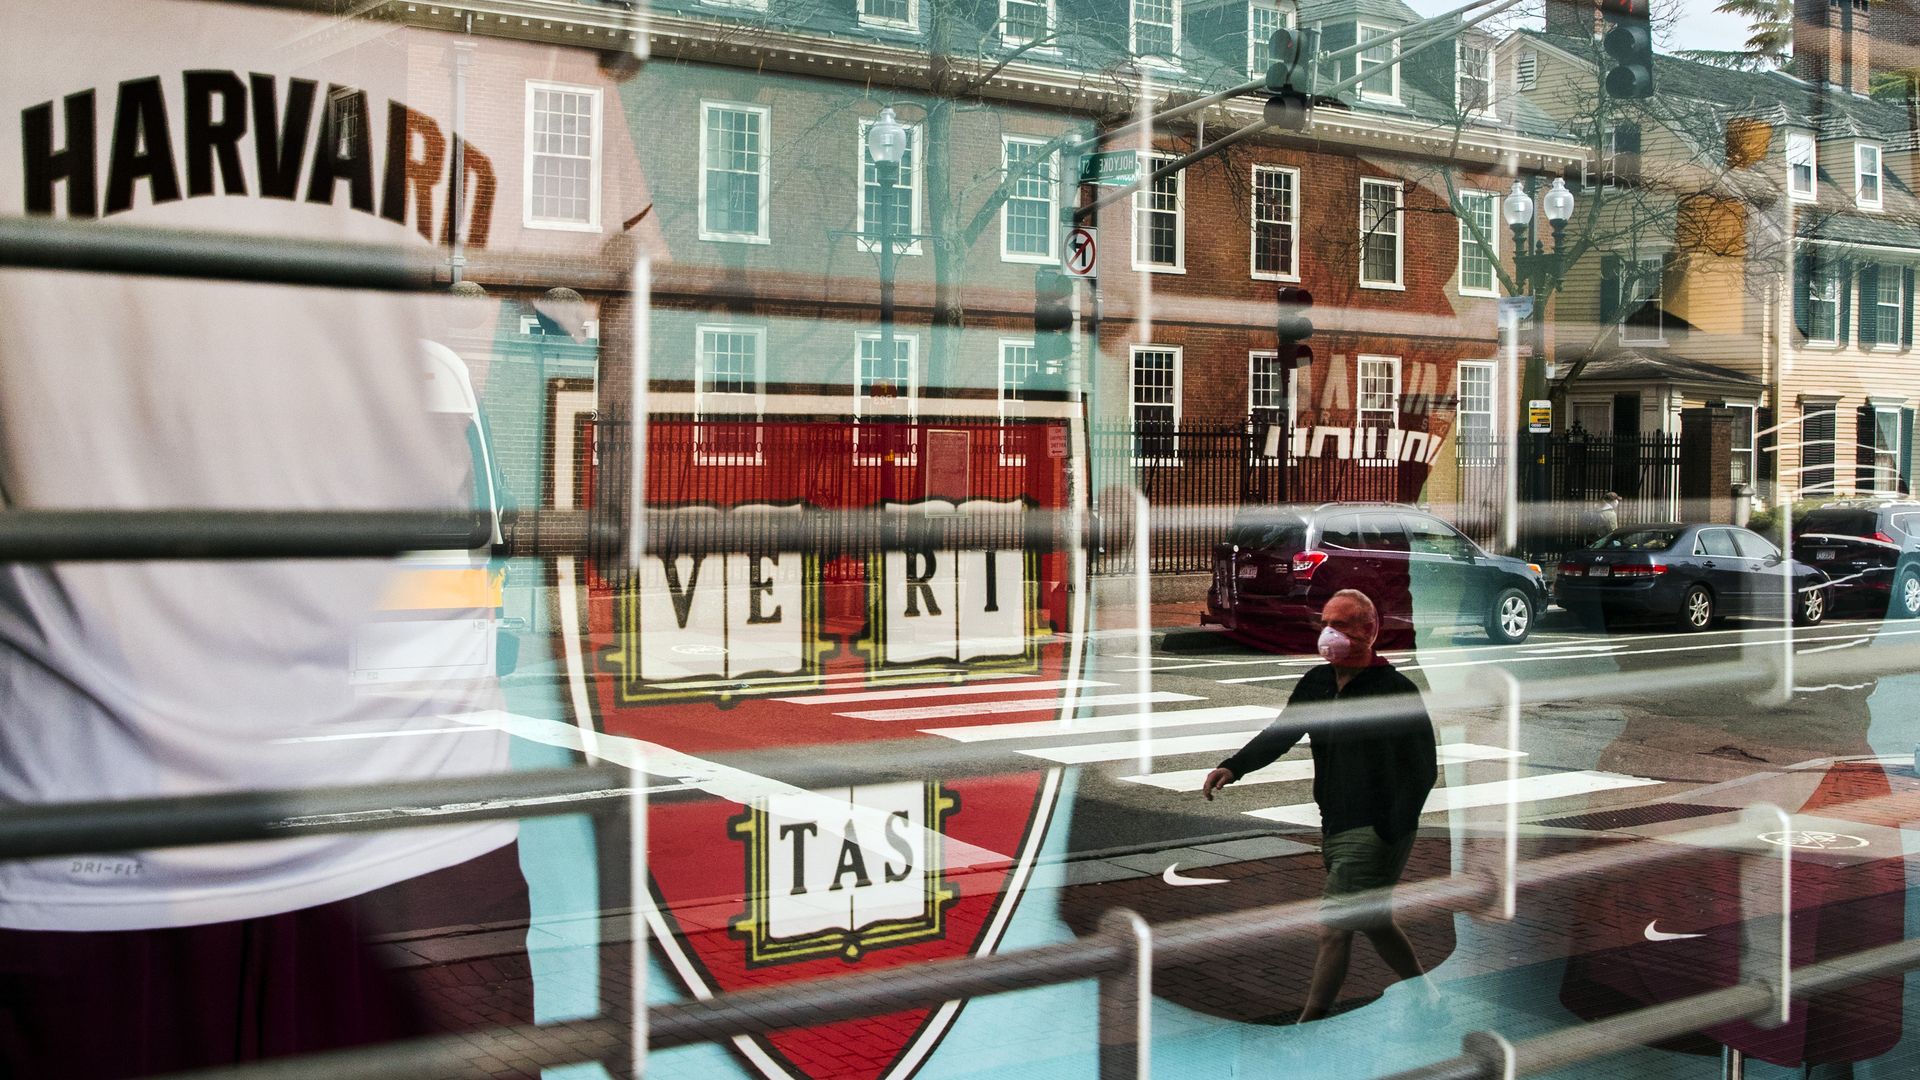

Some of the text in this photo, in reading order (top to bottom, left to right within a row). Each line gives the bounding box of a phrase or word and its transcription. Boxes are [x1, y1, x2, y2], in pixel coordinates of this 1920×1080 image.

[21, 69, 497, 249] HARVARD
[71, 861, 143, 876] DRI-FIT
[779, 810, 914, 896] TAS
